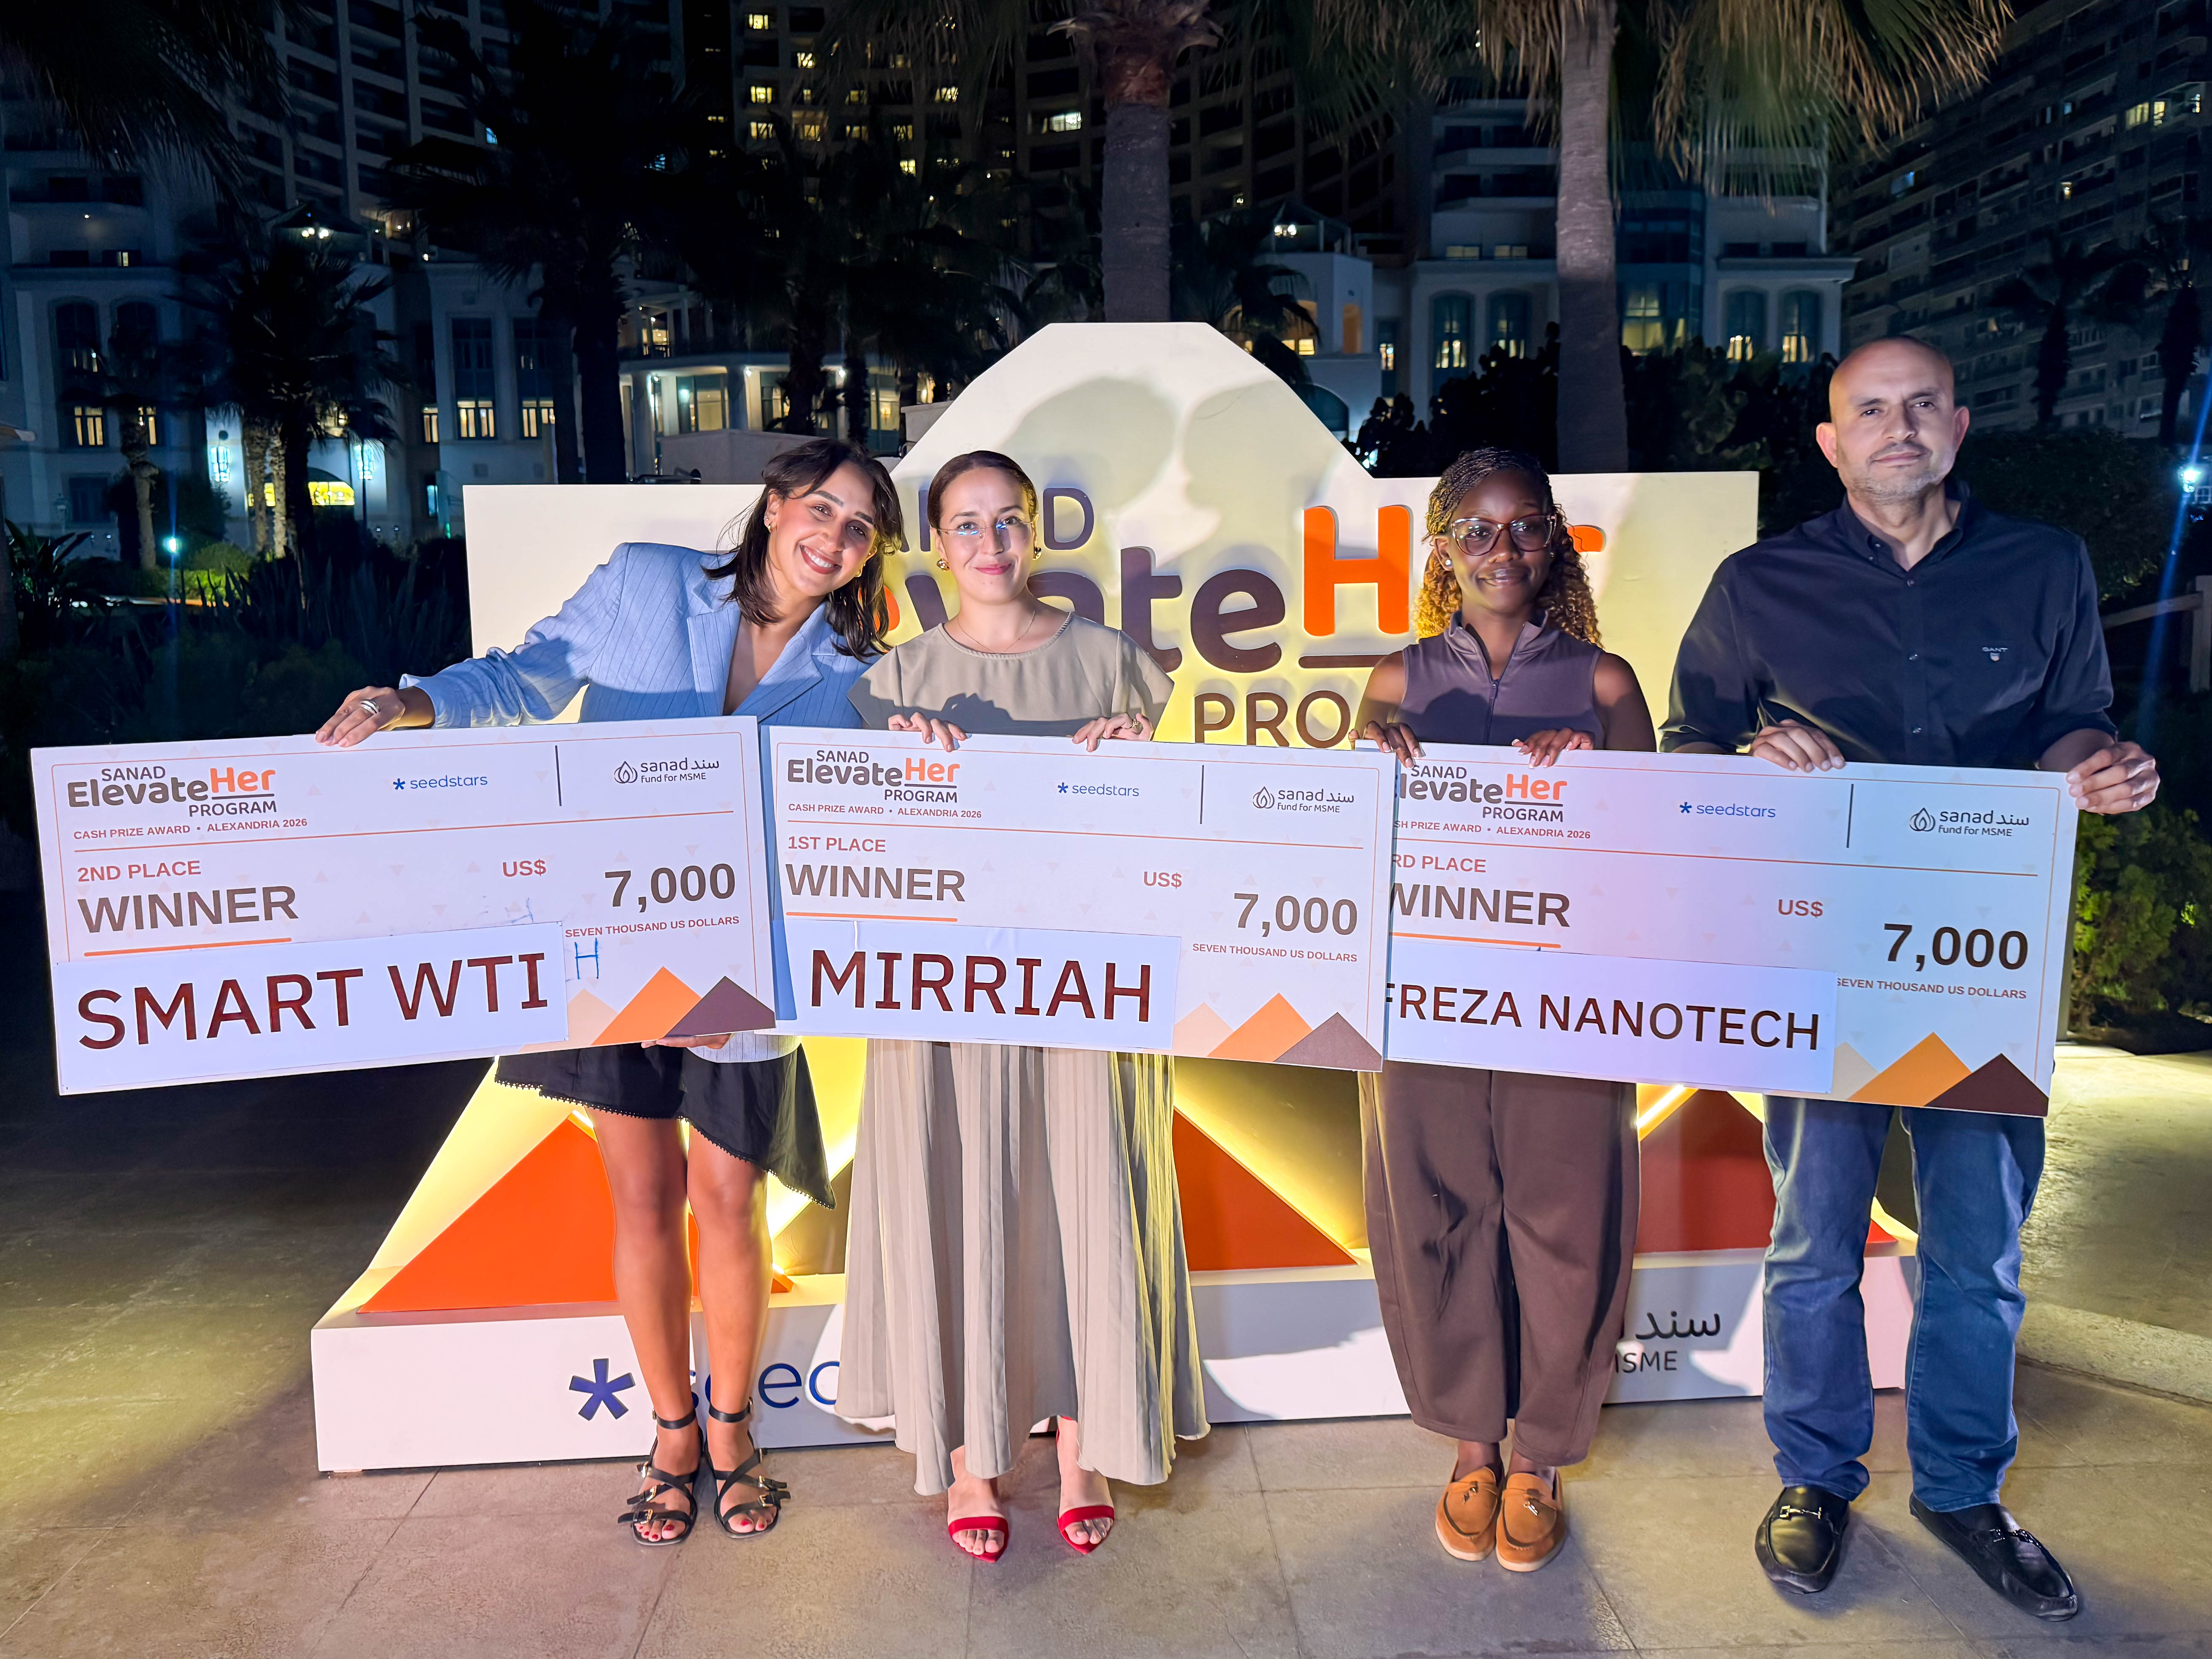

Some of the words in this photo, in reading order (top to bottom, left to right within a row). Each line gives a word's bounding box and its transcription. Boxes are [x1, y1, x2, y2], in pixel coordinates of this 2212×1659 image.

[640, 757, 688, 772] sanad
[691, 760, 720, 770] سند
[816, 750, 869, 763] SANAD
[102, 766, 165, 781] SANAD
[680, 772, 706, 781] MSME
[1411, 765, 1467, 779] SANAD
[410, 774, 488, 789] seedstars
[1072, 783, 1139, 796] seedstars
[1400, 774, 1567, 804] levateHer
[885, 790, 957, 803] PROGRAM
[1278, 789, 1324, 801] sanad
[1326, 793, 1354, 803] سند
[189, 801, 277, 817] PROGRAM
[788, 804, 815, 812] CASH
[818, 804, 846, 812] PRIZE
[848, 806, 884, 814] AWARD
[898, 808, 958, 817] ALEXANDRIA
[1314, 804, 1340, 813] MSME
[1482, 807, 1564, 823] PROGRAM
[1696, 803, 1776, 818] seedstars
[1940, 810, 1994, 824] sanad
[73, 829, 107, 839] CASH
[110, 827, 143, 838] PRIZE
[147, 824, 191, 836] AWARD
[207, 820, 280, 832] ALEXANDRIA
[283, 818, 308, 828] 2026
[1996, 815, 2029, 825] سند
[1394, 820, 1408, 828] SH
[1411, 821, 1440, 831] PRIZE
[1443, 823, 1482, 833] AWARD
[1497, 826, 1564, 837] ALEXANDRIA
[1567, 830, 1590, 839] 2026
[1982, 828, 2012, 836] MSME
[788, 836, 821, 850] 1ST
[826, 837, 886, 852] PLACE
[77, 865, 121, 882] 2ND
[128, 860, 201, 879] PLACE
[502, 859, 547, 878] US$
[1393, 854, 1416, 868] RD
[1422, 856, 1486, 872] PLACE
[605, 863, 735, 913] 7,000
[785, 863, 965, 901] WINNER
[1144, 871, 1182, 889] US$
[77, 885, 299, 933] WINNER
[1234, 893, 1357, 937] 7,000
[1778, 899, 1824, 918] US$
[565, 927, 603, 938] SEVEN
[605, 922, 667, 934] THOUSAND
[670, 921, 685, 930] US
[689, 916, 739, 928] DOLLARS
[1193, 943, 1226, 953] SEVEN
[1230, 945, 1287, 958] THOUSAND
[1290, 949, 1304, 958] US
[1307, 950, 1357, 962] DOLLARS
[1884, 923, 2028, 972] 7,000
[811, 950, 1151, 1022] MIRRIAH
[1877, 981, 1944, 993] THOUSAND
[1948, 985, 1964, 995] US
[1968, 987, 2026, 999] DOLLARS
[78, 968, 364, 1050] SMART
[387, 952, 548, 1020] WTI
[1539, 994, 1819, 1050] NANOTECH
[1635, 1311, 1721, 1340] سند
[1616, 1350, 1678, 1373] SME
